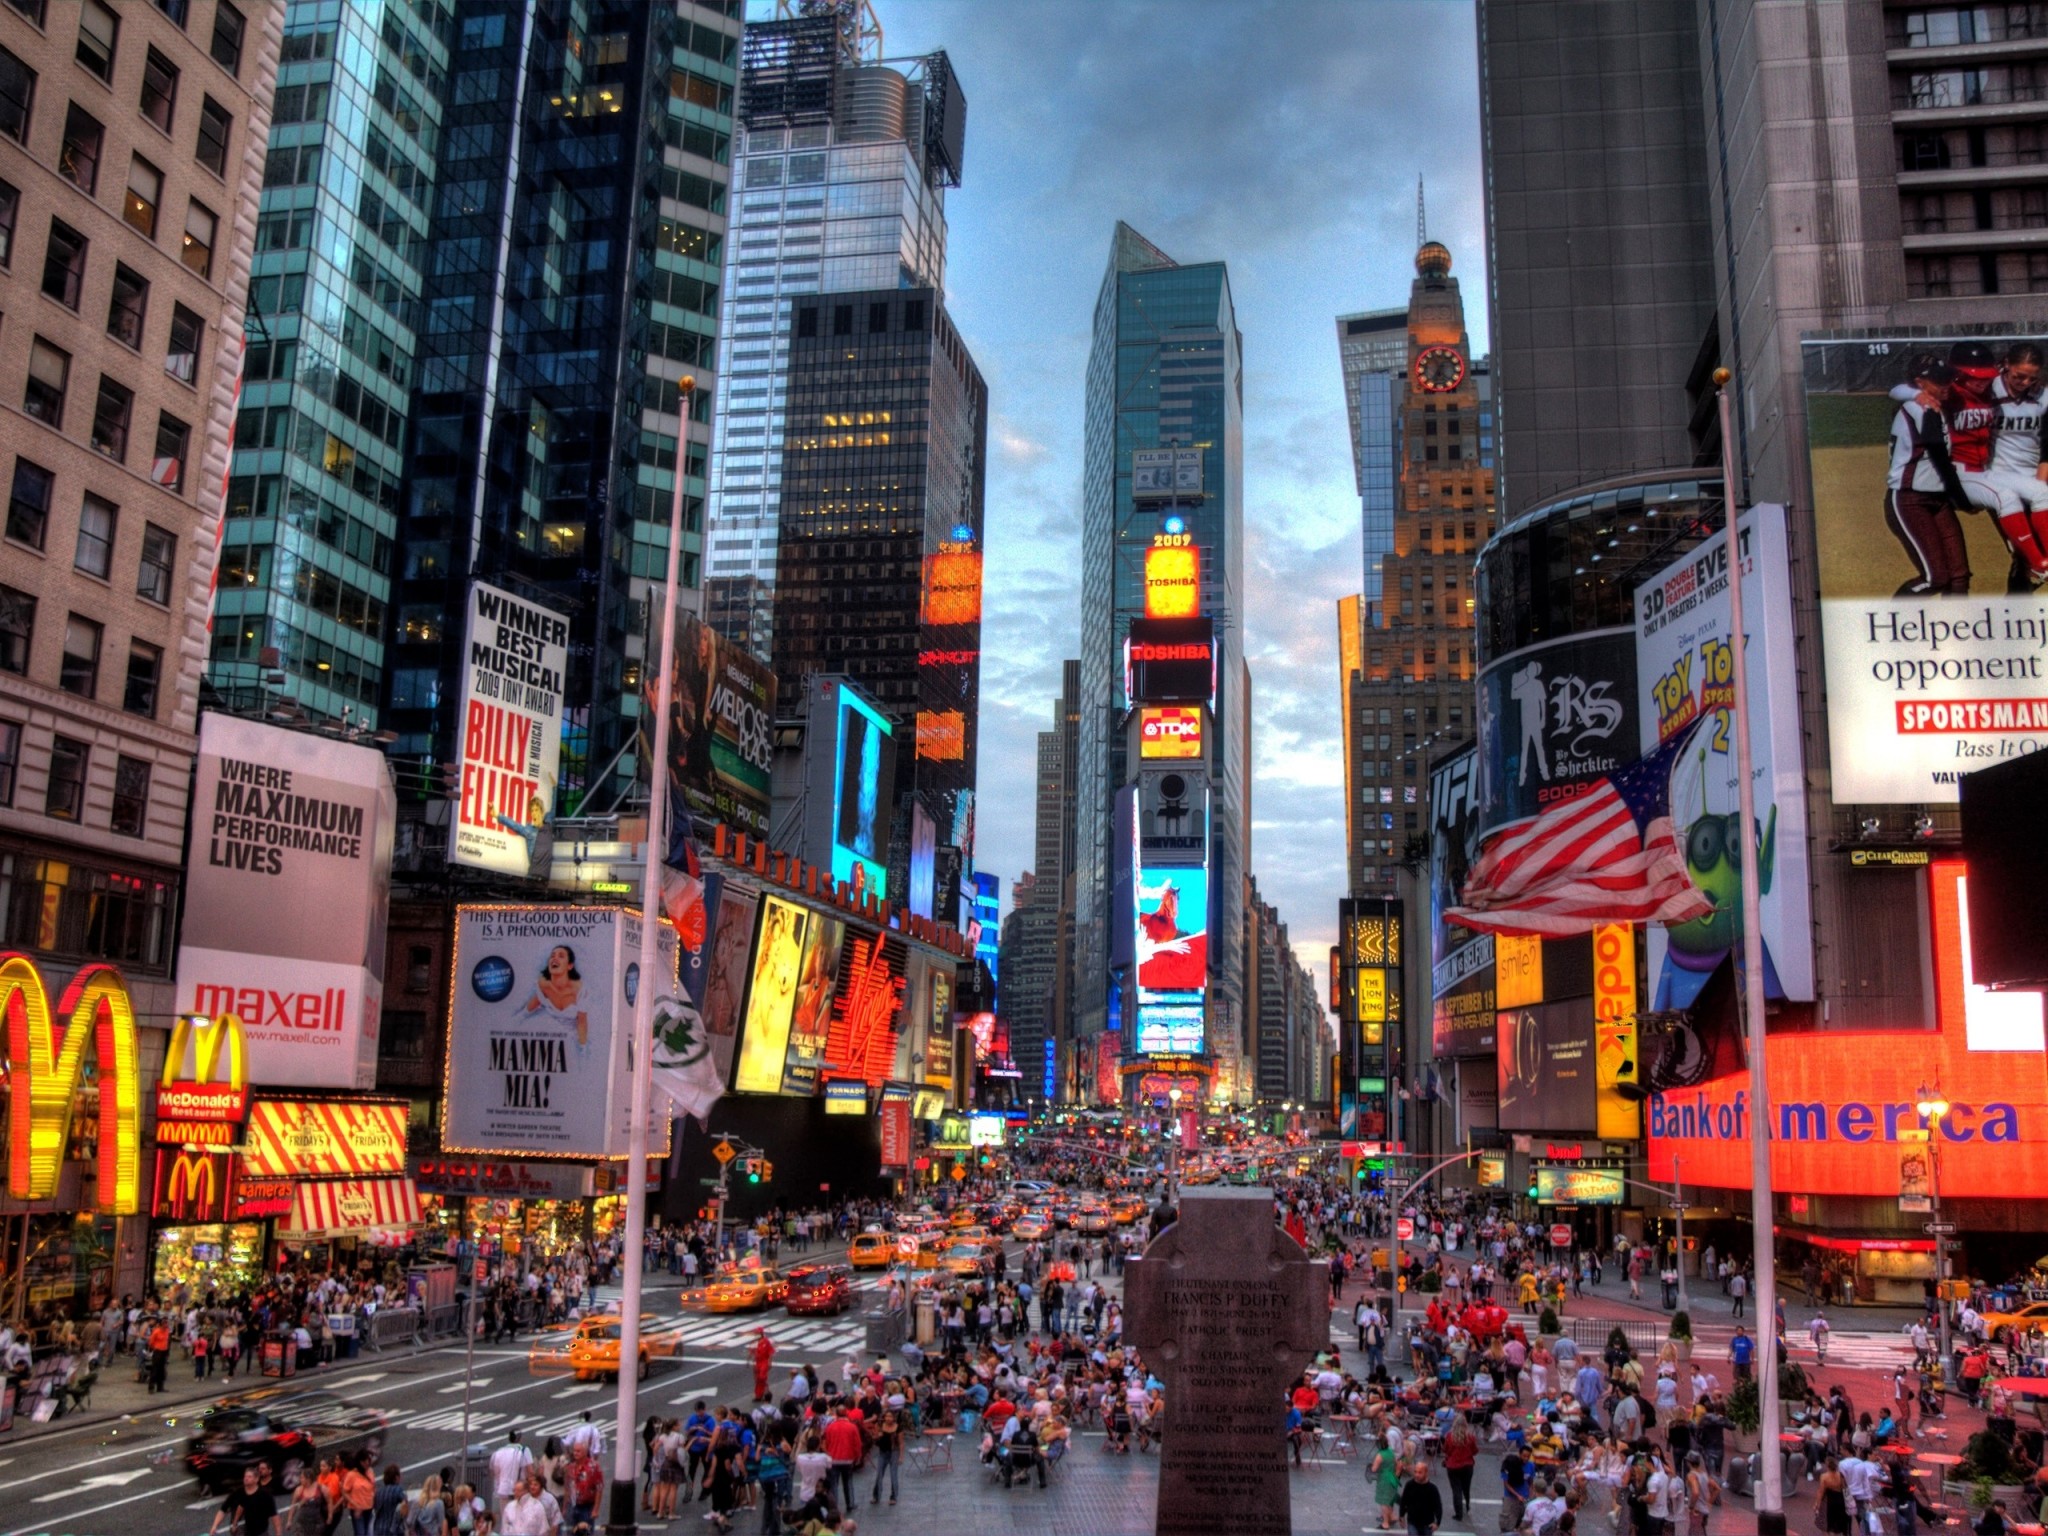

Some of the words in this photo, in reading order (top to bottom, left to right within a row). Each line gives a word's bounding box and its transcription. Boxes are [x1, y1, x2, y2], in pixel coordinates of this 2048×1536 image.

[1868, 344, 1889, 355] 215
[1138, 452, 1156, 462] I'LL
[1158, 452, 1171, 461] BE
[1154, 534, 1191, 547] 2009
[1696, 526, 1750, 588] EVET
[1148, 578, 1197, 586] TOSHIBA
[1665, 564, 1695, 594] DOUBLE
[1666, 577, 1696, 608] FEATURE
[477, 588, 567, 648] WINNER
[1643, 588, 1664, 621] 3D
[1644, 619, 1659, 638] ONLY
[1660, 614, 1667, 629] IN
[1667, 594, 1697, 623] THEATRES
[1699, 590, 1704, 605] 2
[1698, 619, 1717, 637] PIXAR
[1866, 608, 1996, 651] Helped
[496, 624, 546, 663] BEST
[1132, 645, 1210, 661] TOSHIBA
[471, 641, 562, 695] MUSICAL
[1872, 654, 2042, 690] opponent
[476, 669, 500, 698] 2009
[502, 677, 524, 706] TONY
[524, 686, 555, 717] AWARD
[710, 684, 769, 740] MELROSE
[1661, 698, 1696, 739] STORY
[465, 698, 532, 775] BILLY
[530, 720, 544, 761] MUSICAL
[1157, 722, 1196, 736] TDK
[1712, 707, 1731, 755] 2
[739, 729, 772, 774] PLACE
[1955, 738, 1994, 758] Pass
[1998, 738, 2014, 758] It
[221, 757, 293, 792] WHERE
[528, 762, 540, 779] THE
[215, 780, 364, 837] MAXIMUM
[460, 763, 538, 835] ELLIOT
[212, 814, 361, 860] PERFORMANCE
[1142, 836, 1203, 849] CHEVROLET
[209, 838, 283, 876] LIVES
[482, 924, 493, 936] IS
[495, 924, 504, 937] A
[497, 912, 560, 925] FEEL-GOOD
[563, 911, 614, 925] MUSICAL
[1433, 955, 1458, 996] FRANKLIN
[1464, 935, 1494, 973] BELFORT
[1362, 988, 1382, 1001] LION
[1364, 979, 1379, 987] THE
[194, 983, 345, 1031] maxell
[1362, 1002, 1383, 1015] KING
[1446, 991, 1482, 1016] SEPTEMBER
[1483, 989, 1495, 1011] 19
[488, 1038, 568, 1073] MAMMA
[160, 1092, 240, 1108] McDonald's
[503, 1074, 551, 1108] MIA!
[826, 1087, 867, 1095] VORNADO
[171, 1107, 226, 1118] Restaurant
[1651, 1092, 1712, 1138] Bank
[1718, 1091, 1745, 1140] of
[289, 1134, 324, 1148] FRIDAY'S
[355, 1134, 387, 1147] FRIDAY'S
[418, 1161, 532, 1180] DIGITAL
[1537, 1159, 1625, 1169] MARQUIS
[1164, 1291, 1222, 1306] FRANCIS
[1240, 1293, 1291, 1308] DUFFY
[1179, 1325, 1229, 1336] CATHOLIC
[1235, 1326, 1272, 1337] PRIEST
[1175, 1424, 1199, 1434] GOD
[1202, 1425, 1225, 1434] AND
[1227, 1425, 1275, 1435] COUNTRY
